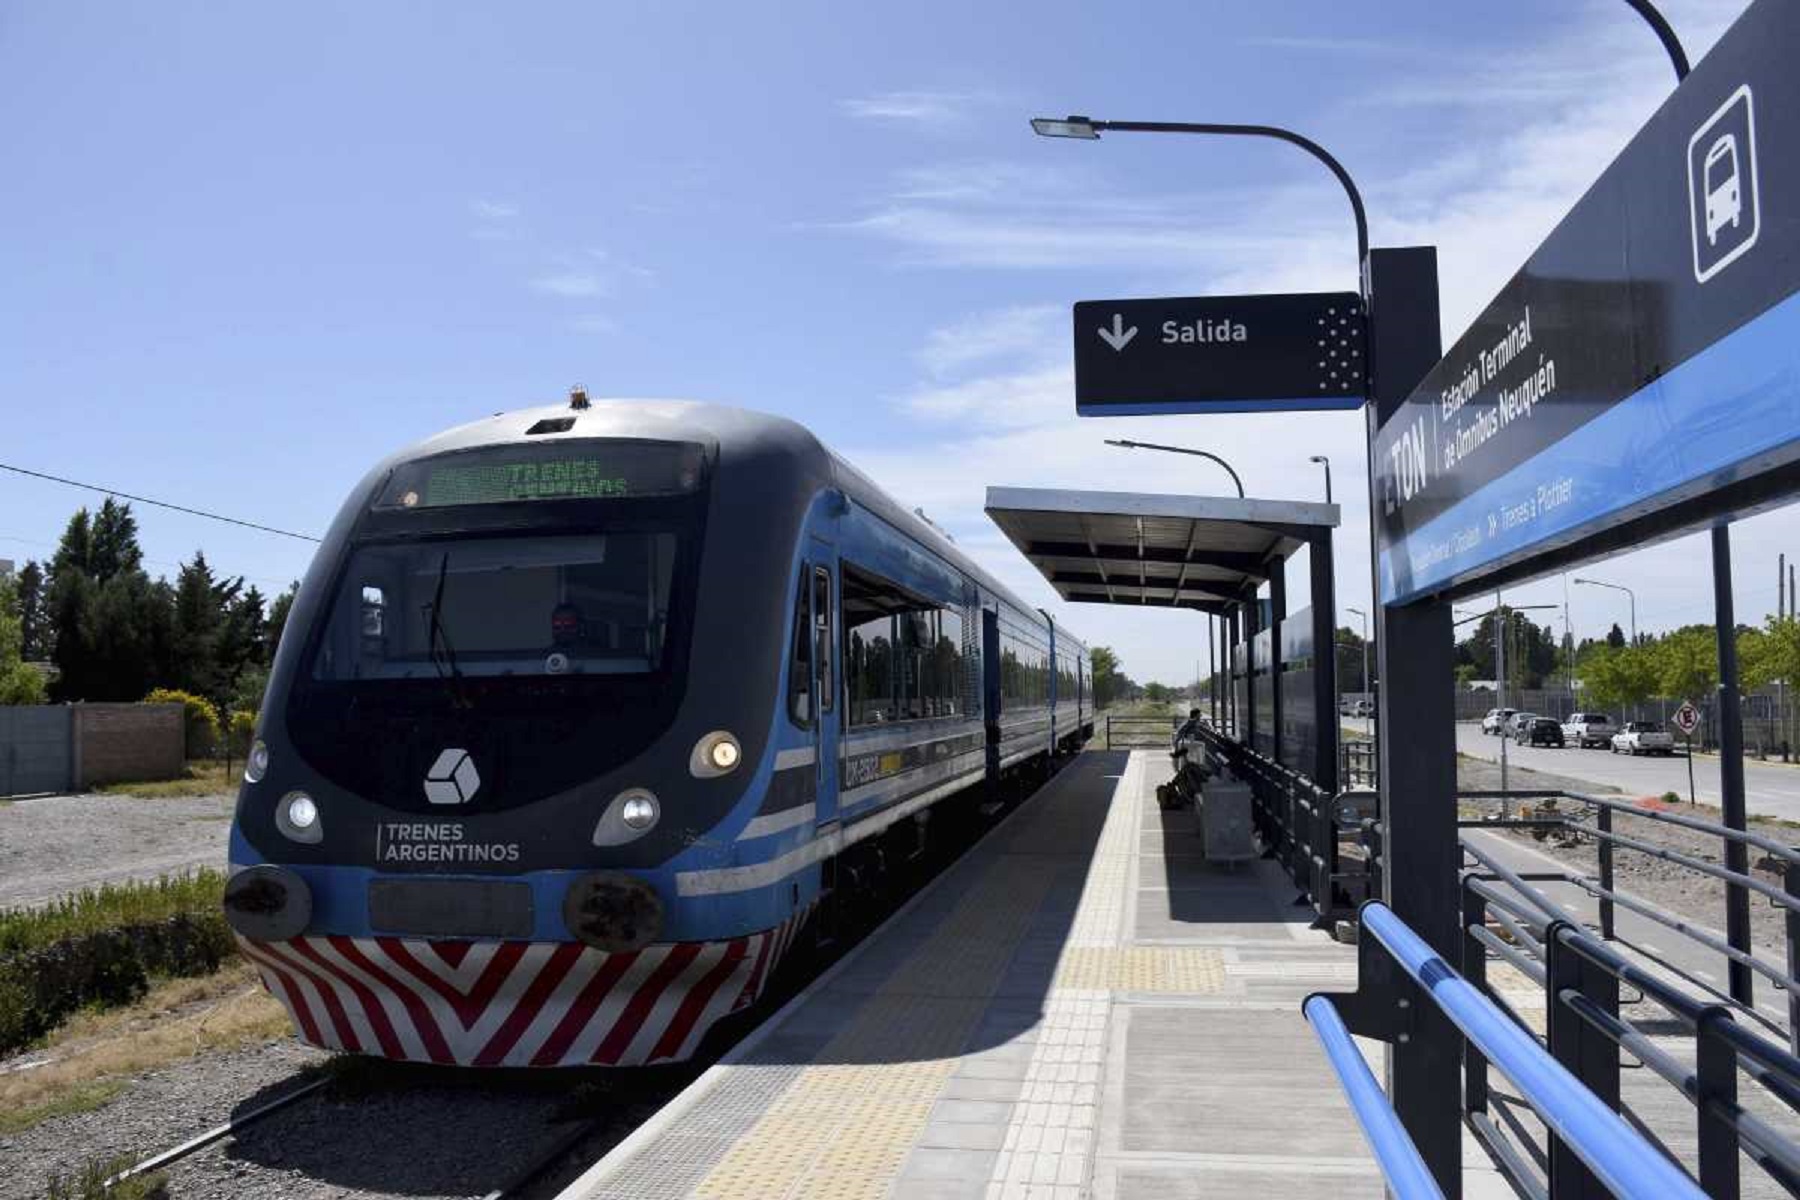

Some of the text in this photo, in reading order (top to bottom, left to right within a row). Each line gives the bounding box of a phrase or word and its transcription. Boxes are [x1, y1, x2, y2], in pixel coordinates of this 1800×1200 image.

[1161, 319, 1248, 344] Salida
[1442, 305, 1532, 421] Estación Terminal
[1445, 353, 1555, 469] de Ómnibus Neuquén
[386, 824, 464, 841] TRENES
[385, 844, 520, 861] ARGENTINOS
